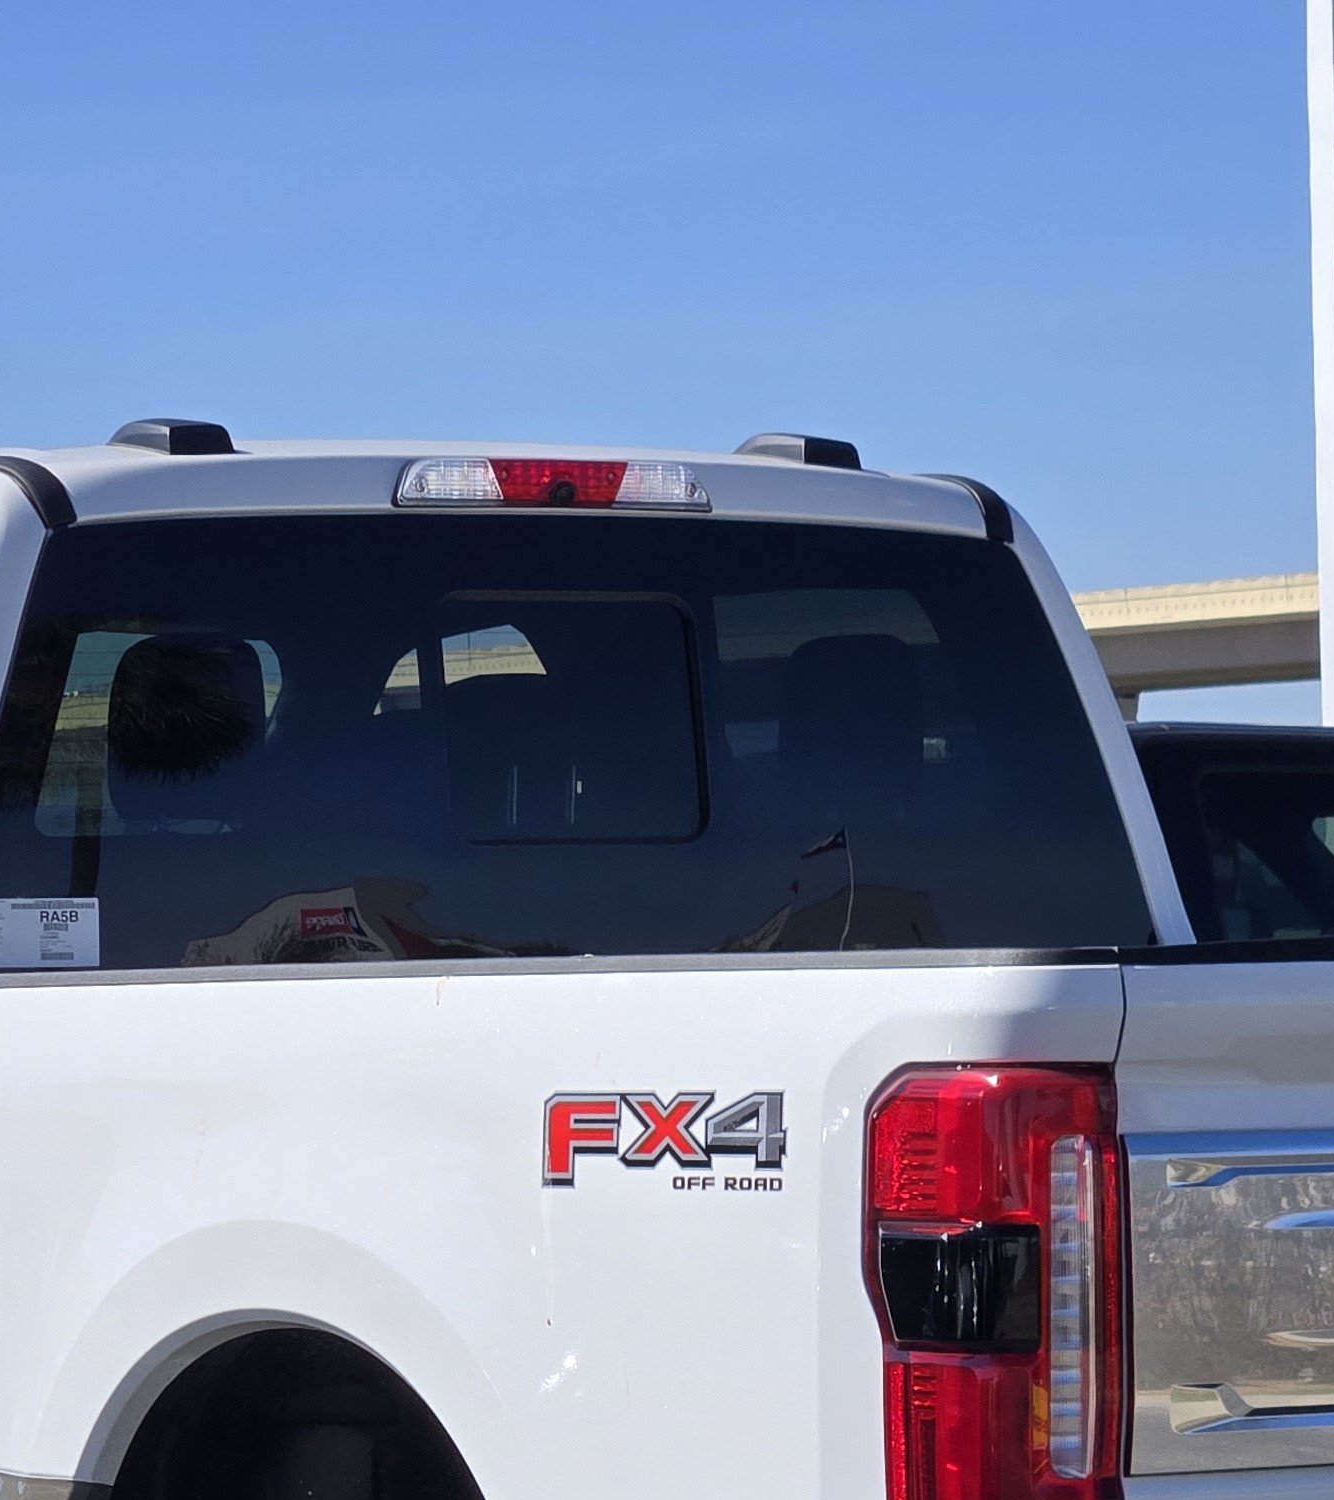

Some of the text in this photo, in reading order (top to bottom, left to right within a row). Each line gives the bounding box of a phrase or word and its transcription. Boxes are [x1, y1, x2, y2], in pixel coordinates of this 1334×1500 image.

[40, 910, 79, 923] RA5B
[542, 1089, 788, 1188] FX4
[672, 1176, 784, 1191] OFF ROAD
